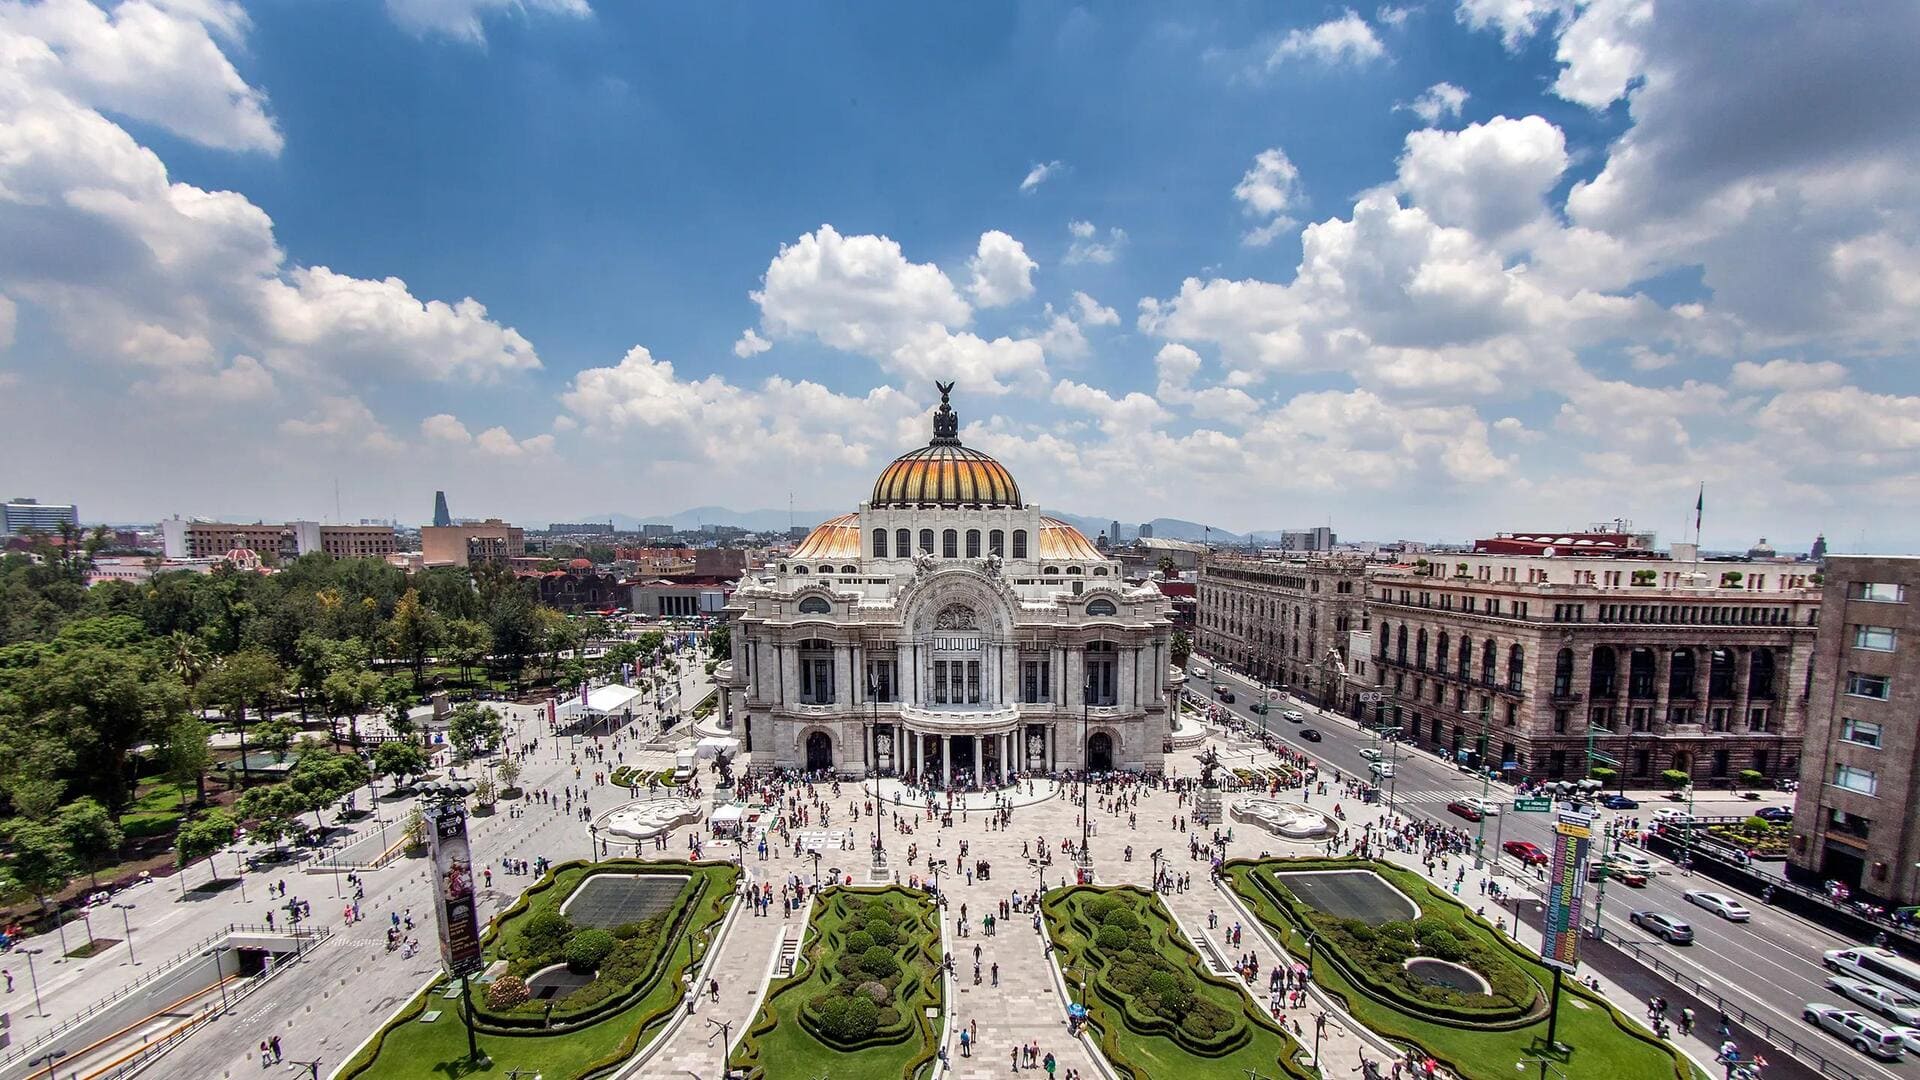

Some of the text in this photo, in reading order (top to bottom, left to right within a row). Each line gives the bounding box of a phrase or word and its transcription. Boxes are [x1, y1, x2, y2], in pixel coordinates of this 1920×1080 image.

[1553, 835, 1567, 884] MONTENEGRO
[1565, 836, 1578, 865] LOZANO
[1549, 885, 1562, 922] CAMARENA
[1568, 899, 1580, 927] TAMAYO
[1563, 928, 1577, 964] SIQUEIROS
